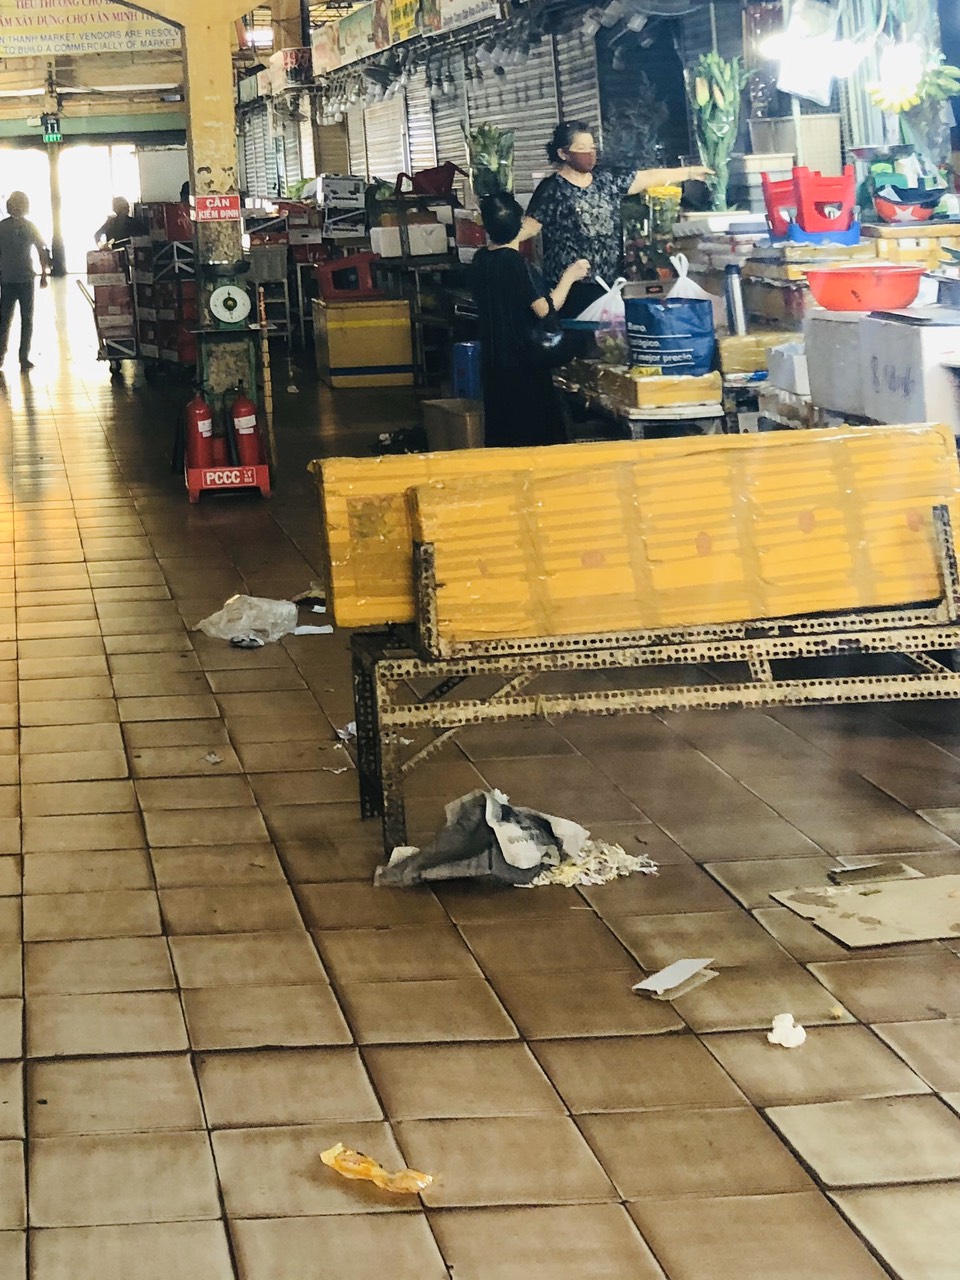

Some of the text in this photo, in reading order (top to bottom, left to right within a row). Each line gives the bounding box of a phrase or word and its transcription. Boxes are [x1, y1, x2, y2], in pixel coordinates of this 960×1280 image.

[111, 9, 138, 22] MINH
[7, 34, 38, 44] THANH
[39, 32, 76, 43] MARKET
[78, 30, 122, 41] VENDORS
[124, 29, 142, 39] ARE
[3, 38, 177, 55] TO BUILD A COMMERCIALLY OF MARKET
[205, 196, 231, 208] CÂN
[206, 470, 241, 485] PCCC
